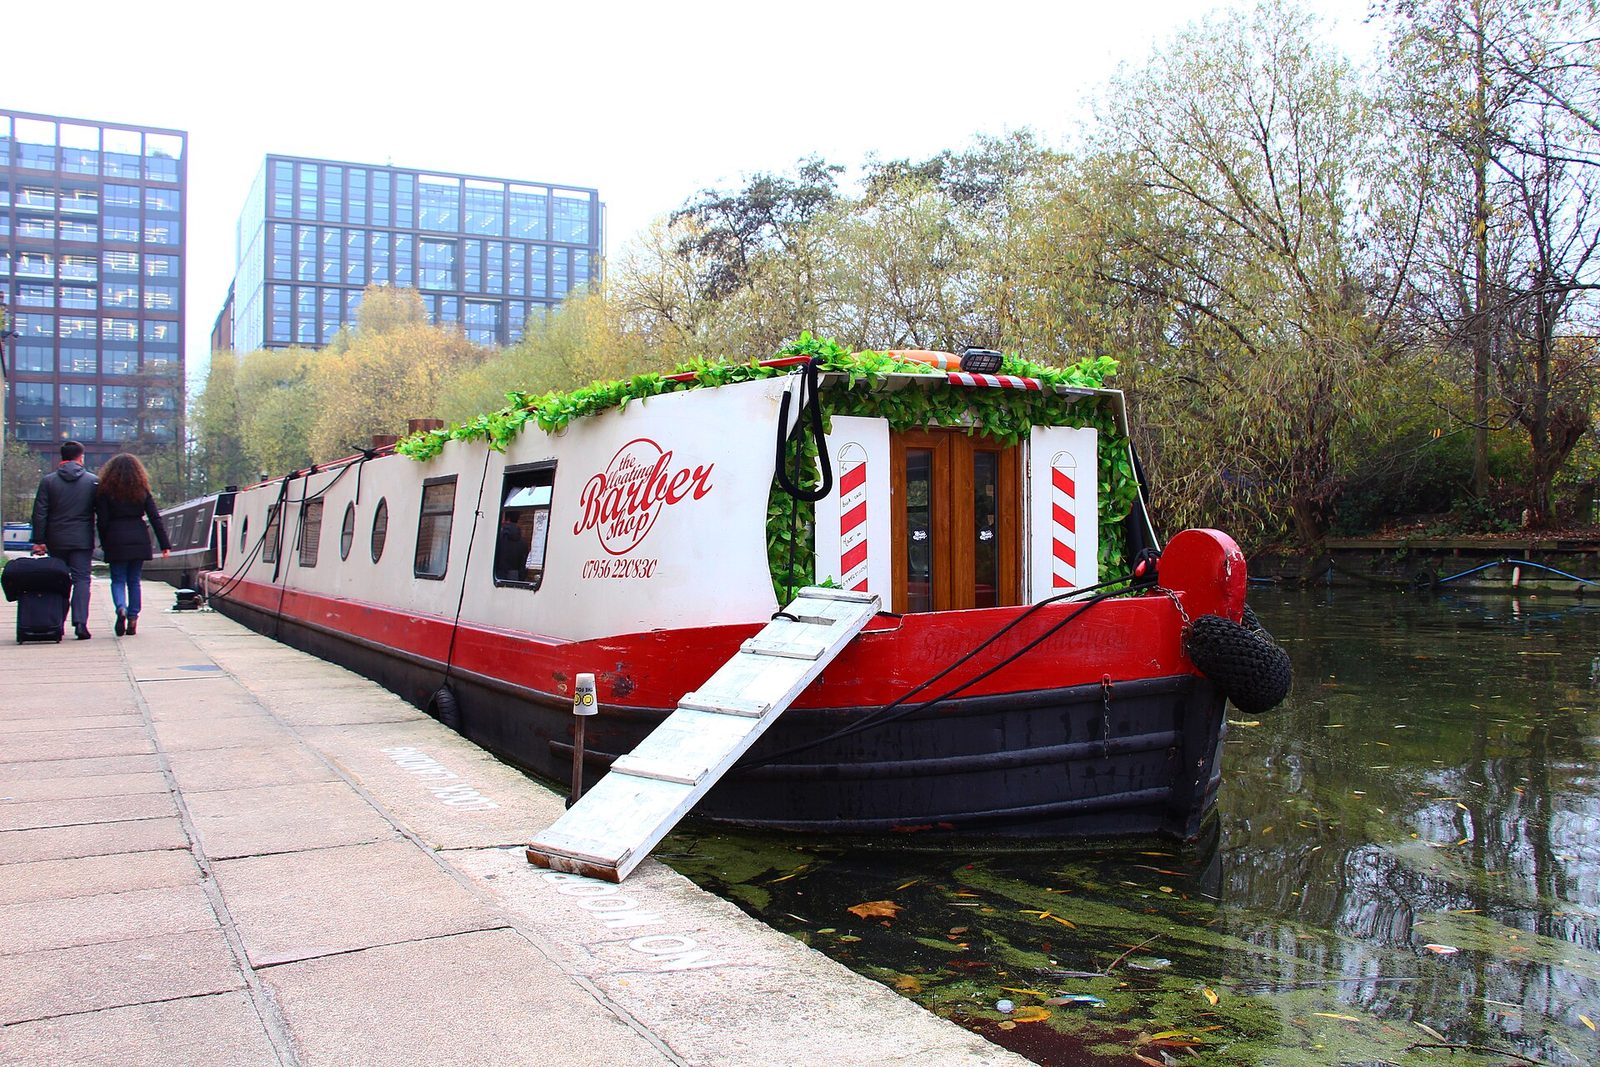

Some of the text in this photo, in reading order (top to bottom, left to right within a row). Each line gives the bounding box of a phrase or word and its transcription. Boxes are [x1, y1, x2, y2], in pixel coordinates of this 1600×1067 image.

[618, 453, 636, 471] the
[573, 450, 715, 535] Barber
[606, 508, 650, 541] shop
[582, 559, 658, 579] 07956 220830
[425, 783, 500, 811] LOCK
[528, 864, 729, 971] NO MOOR
